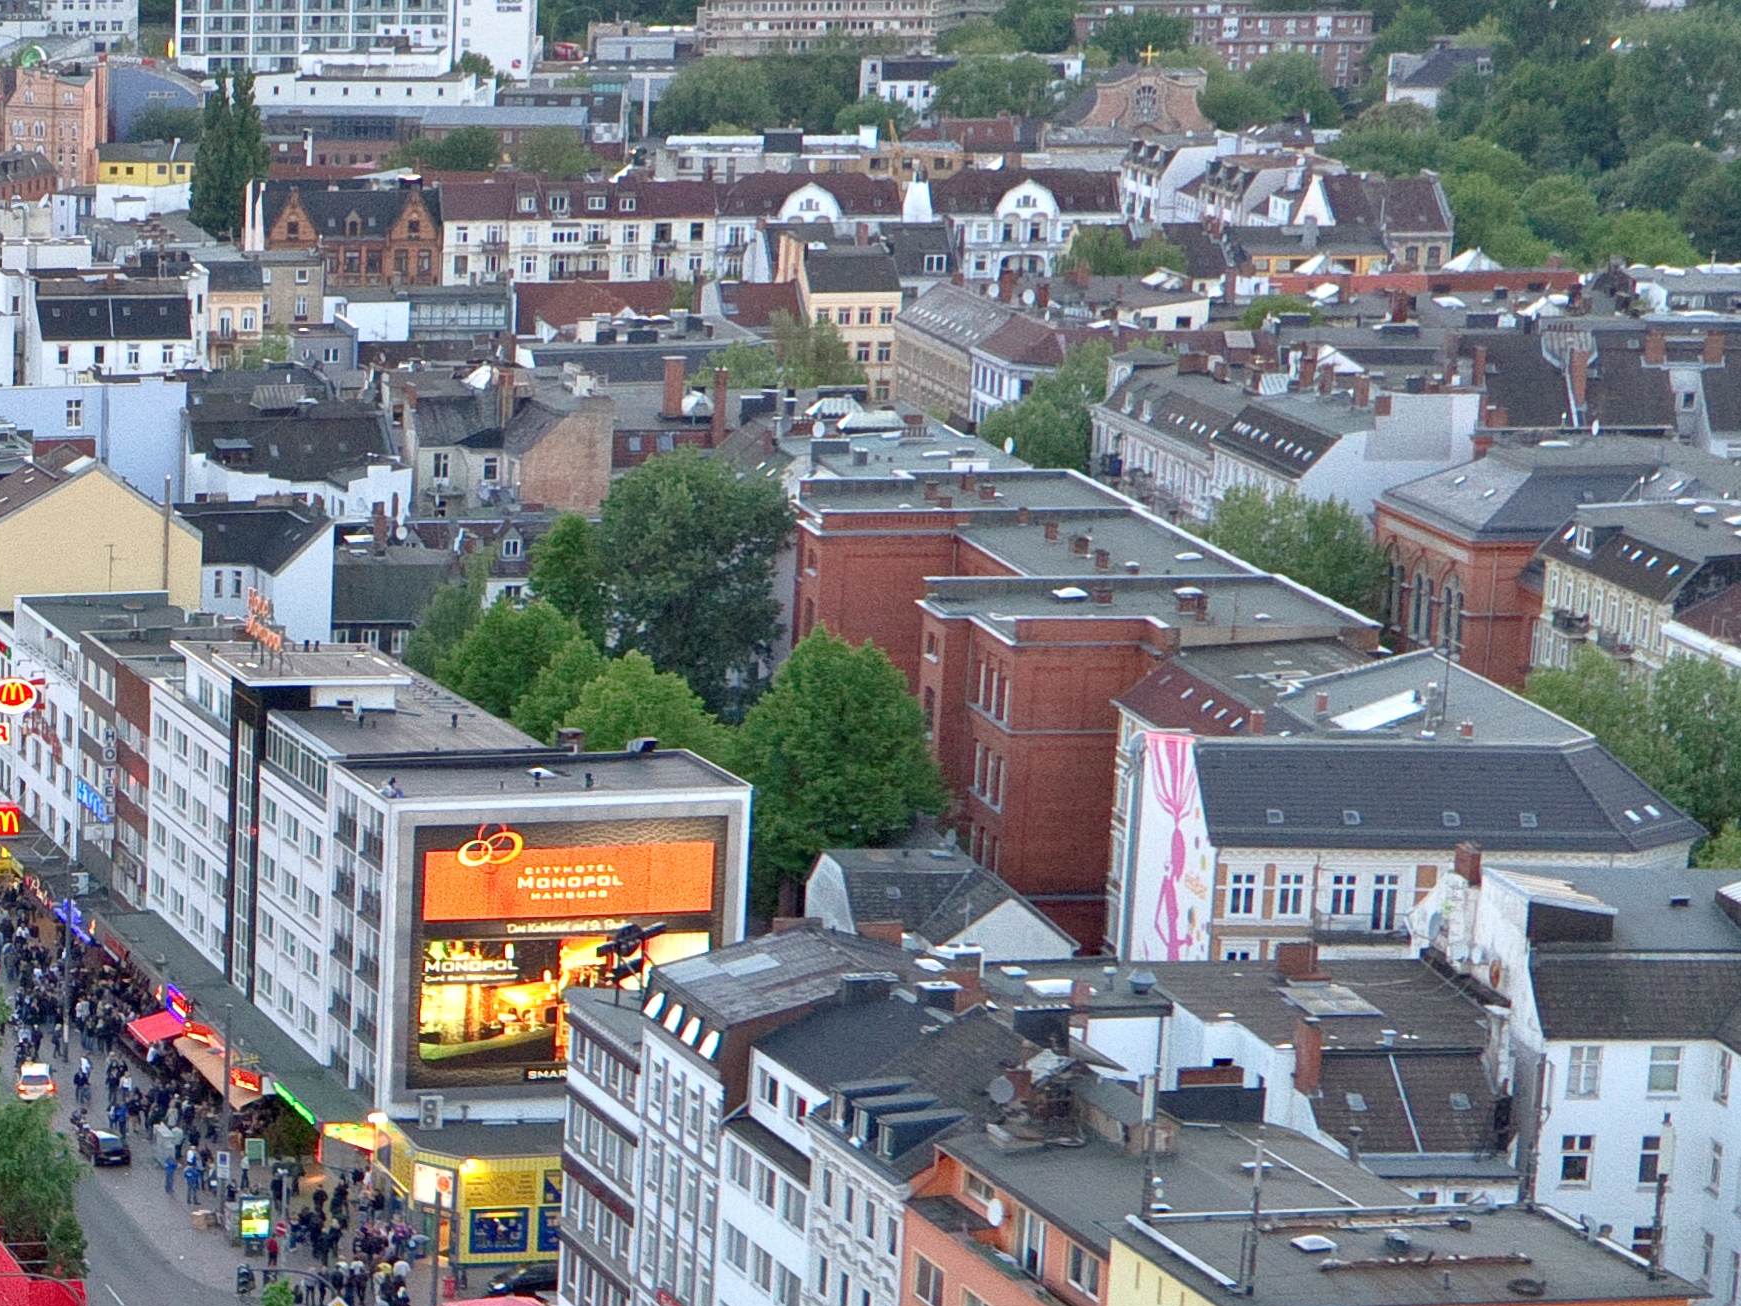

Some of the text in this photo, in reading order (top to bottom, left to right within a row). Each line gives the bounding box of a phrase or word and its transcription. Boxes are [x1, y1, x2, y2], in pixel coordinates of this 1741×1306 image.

[104, 729, 116, 816] HOTEL
[524, 864, 616, 875] CITYHOTEL
[517, 874, 624, 889] MONOPOL
[530, 890, 608, 900] HAMBURG
[424, 960, 519, 973] MONOPOL
